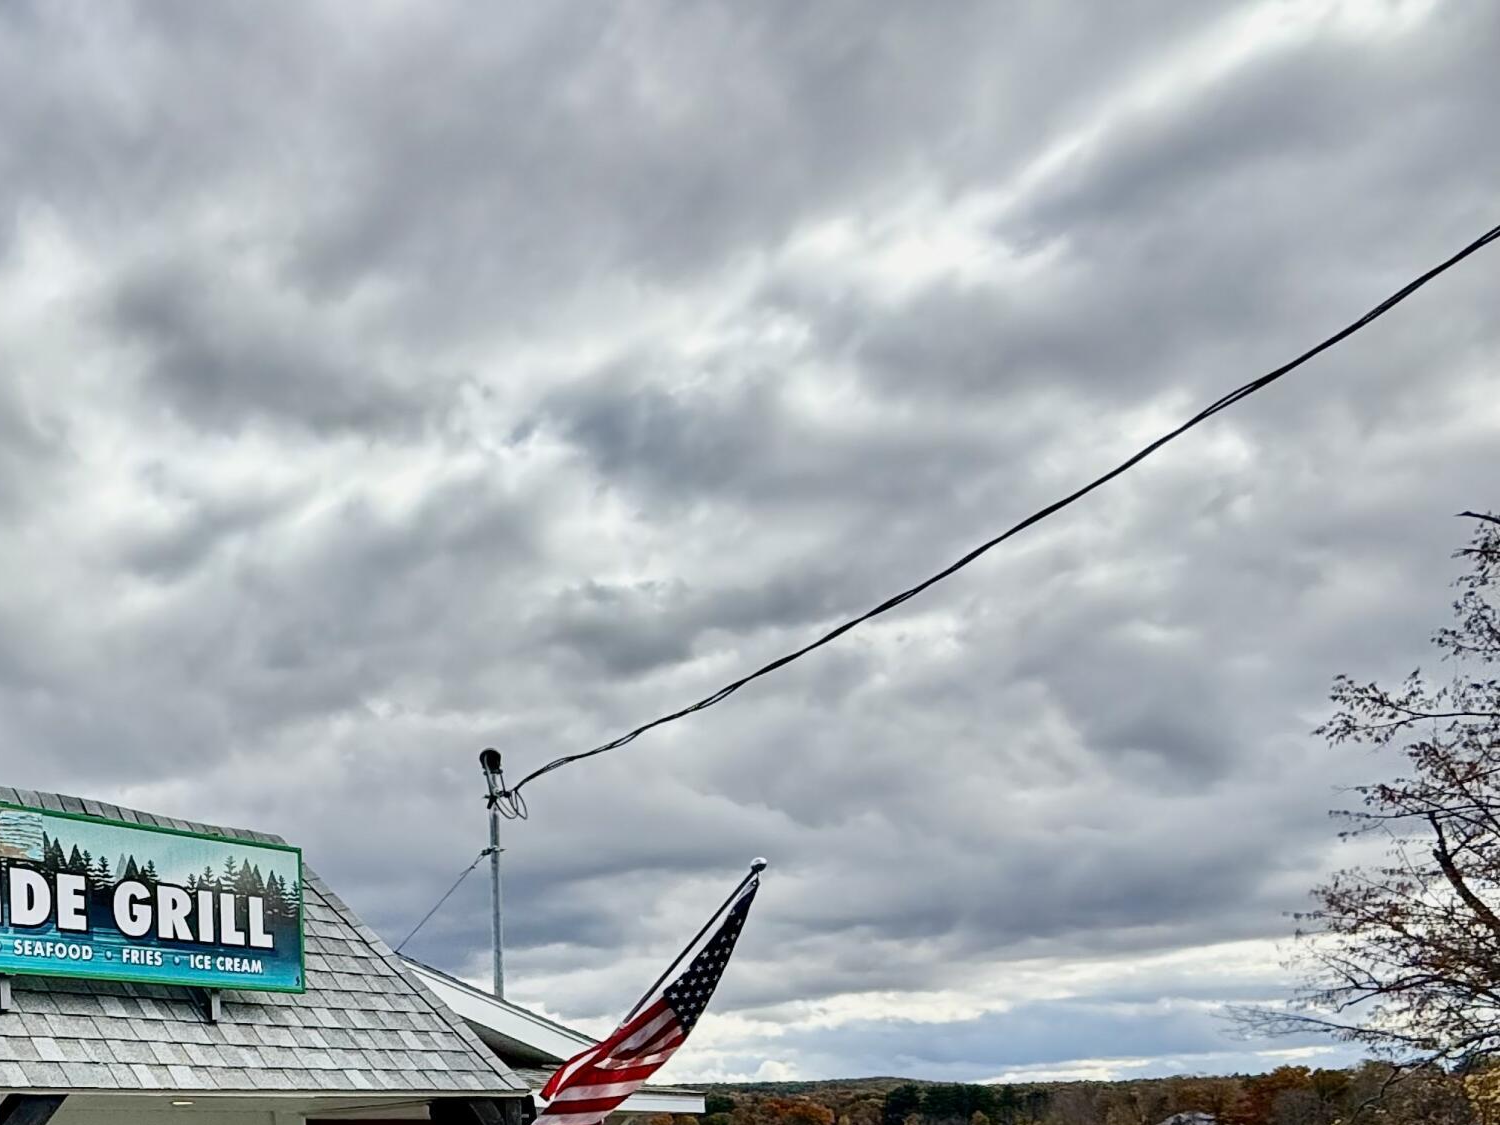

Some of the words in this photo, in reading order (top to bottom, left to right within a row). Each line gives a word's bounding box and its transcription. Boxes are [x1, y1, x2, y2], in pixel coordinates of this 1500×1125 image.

[113, 881, 274, 948] GRILL
[13, 939, 93, 960] SEAFOOD
[122, 949, 163, 967] FRIES
[190, 954, 211, 970] ICE
[216, 957, 263, 974] CREAM
